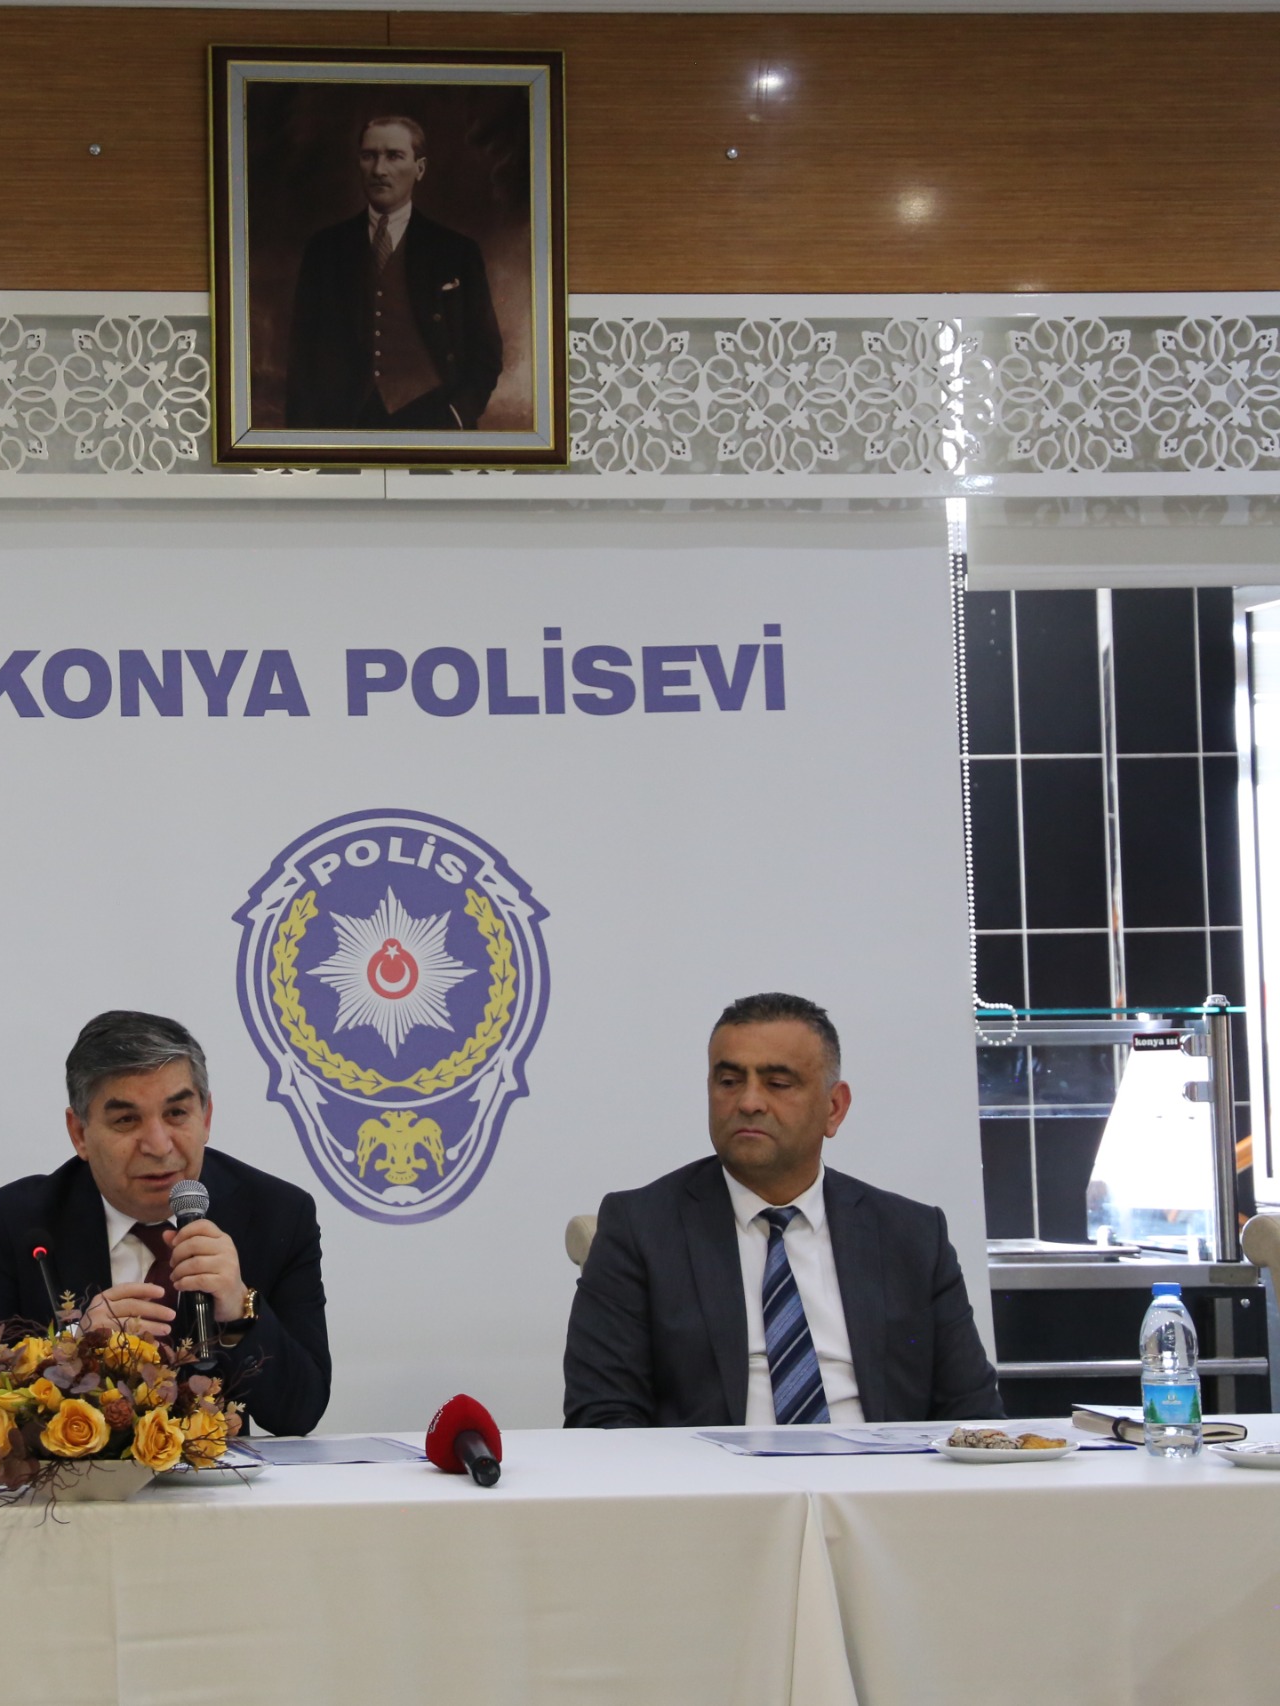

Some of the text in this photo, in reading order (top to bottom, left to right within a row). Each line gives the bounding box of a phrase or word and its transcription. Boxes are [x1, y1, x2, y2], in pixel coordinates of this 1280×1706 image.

[346, 624, 786, 716] POLİSEVİ
[309, 835, 468, 887] POLİS
[1135, 1037, 1164, 1047] konya
